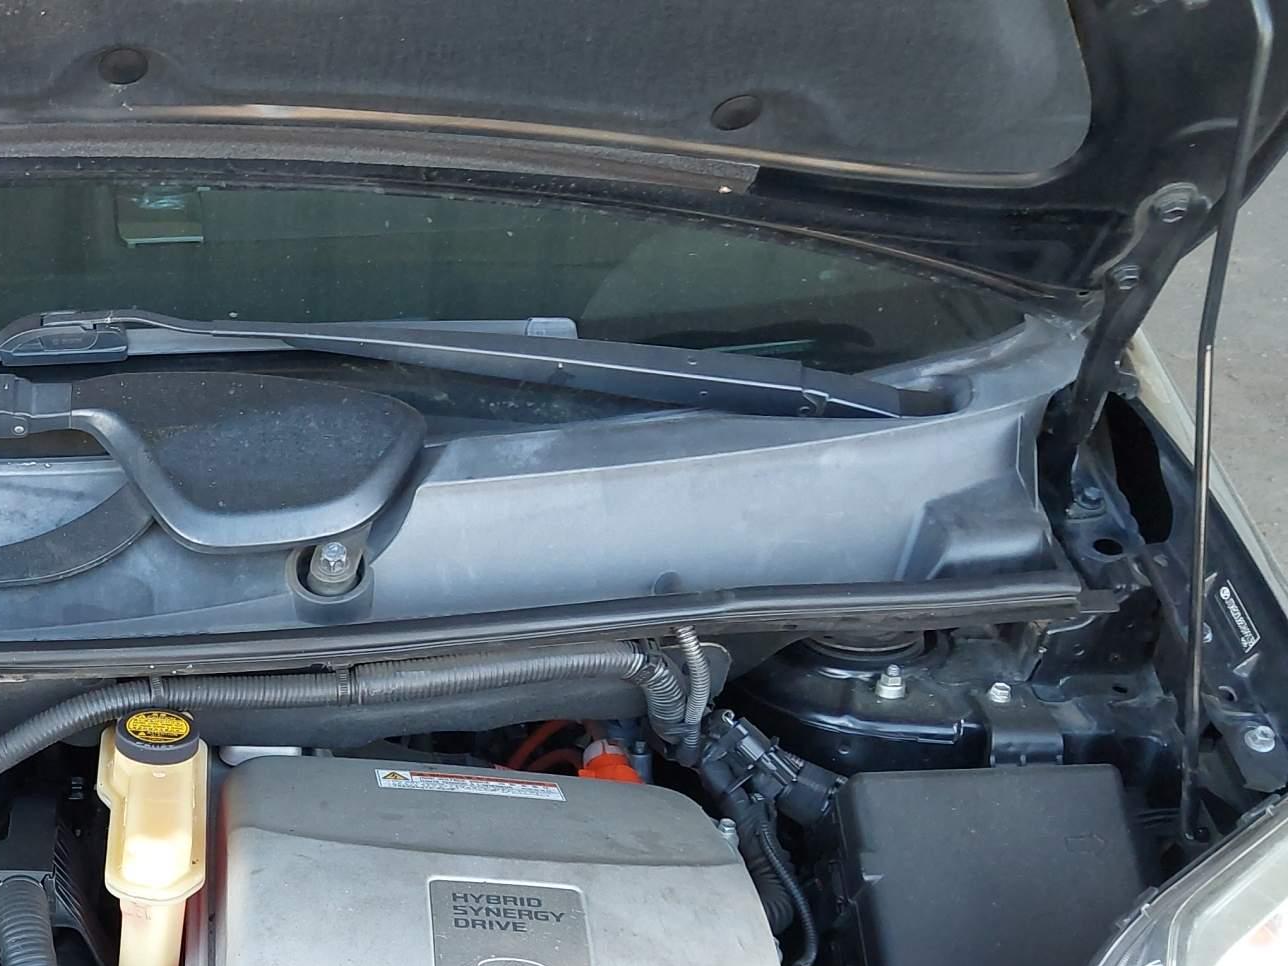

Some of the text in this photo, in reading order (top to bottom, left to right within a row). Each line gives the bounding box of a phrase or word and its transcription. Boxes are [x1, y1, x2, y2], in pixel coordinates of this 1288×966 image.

[452, 892, 542, 908] HYBRID
[453, 905, 566, 923] SYNERGY
[454, 917, 528, 933] DRIVE
